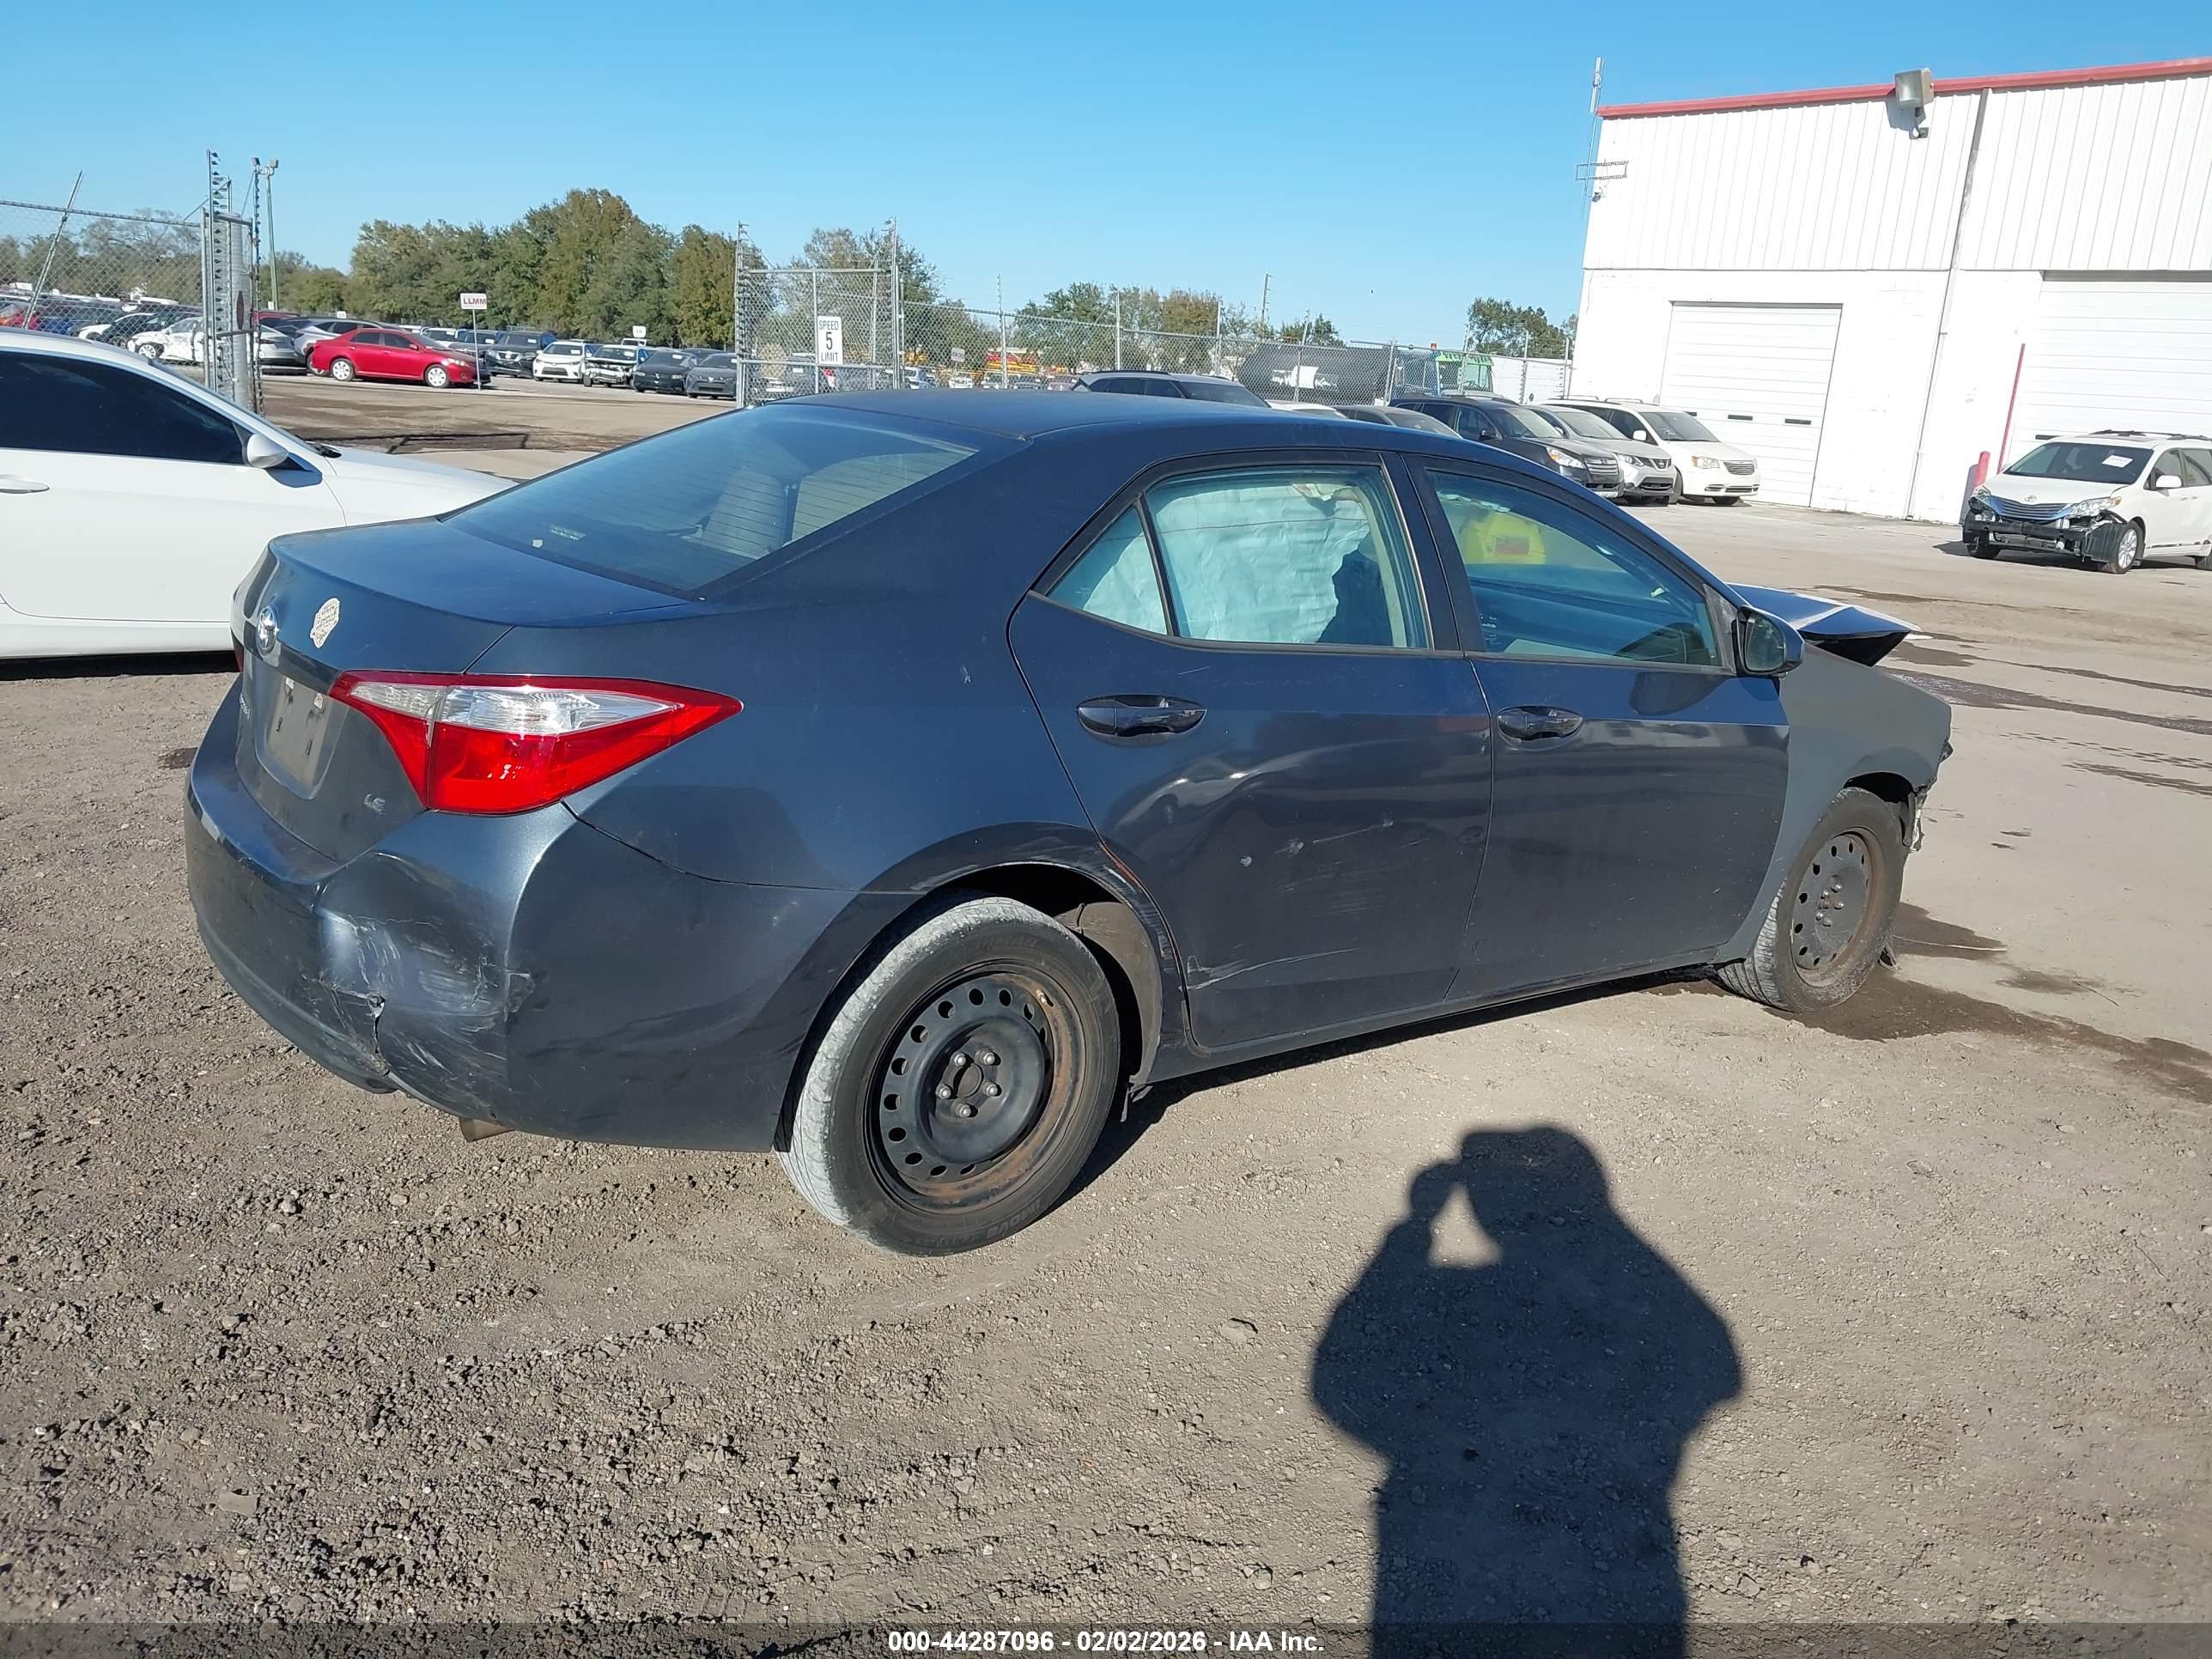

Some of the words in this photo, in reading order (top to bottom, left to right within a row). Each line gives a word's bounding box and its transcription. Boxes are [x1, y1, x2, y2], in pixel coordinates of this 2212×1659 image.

[818, 320, 839, 330] SPEED
[826, 331, 833, 350] 5
[821, 352, 838, 362] LIMIT
